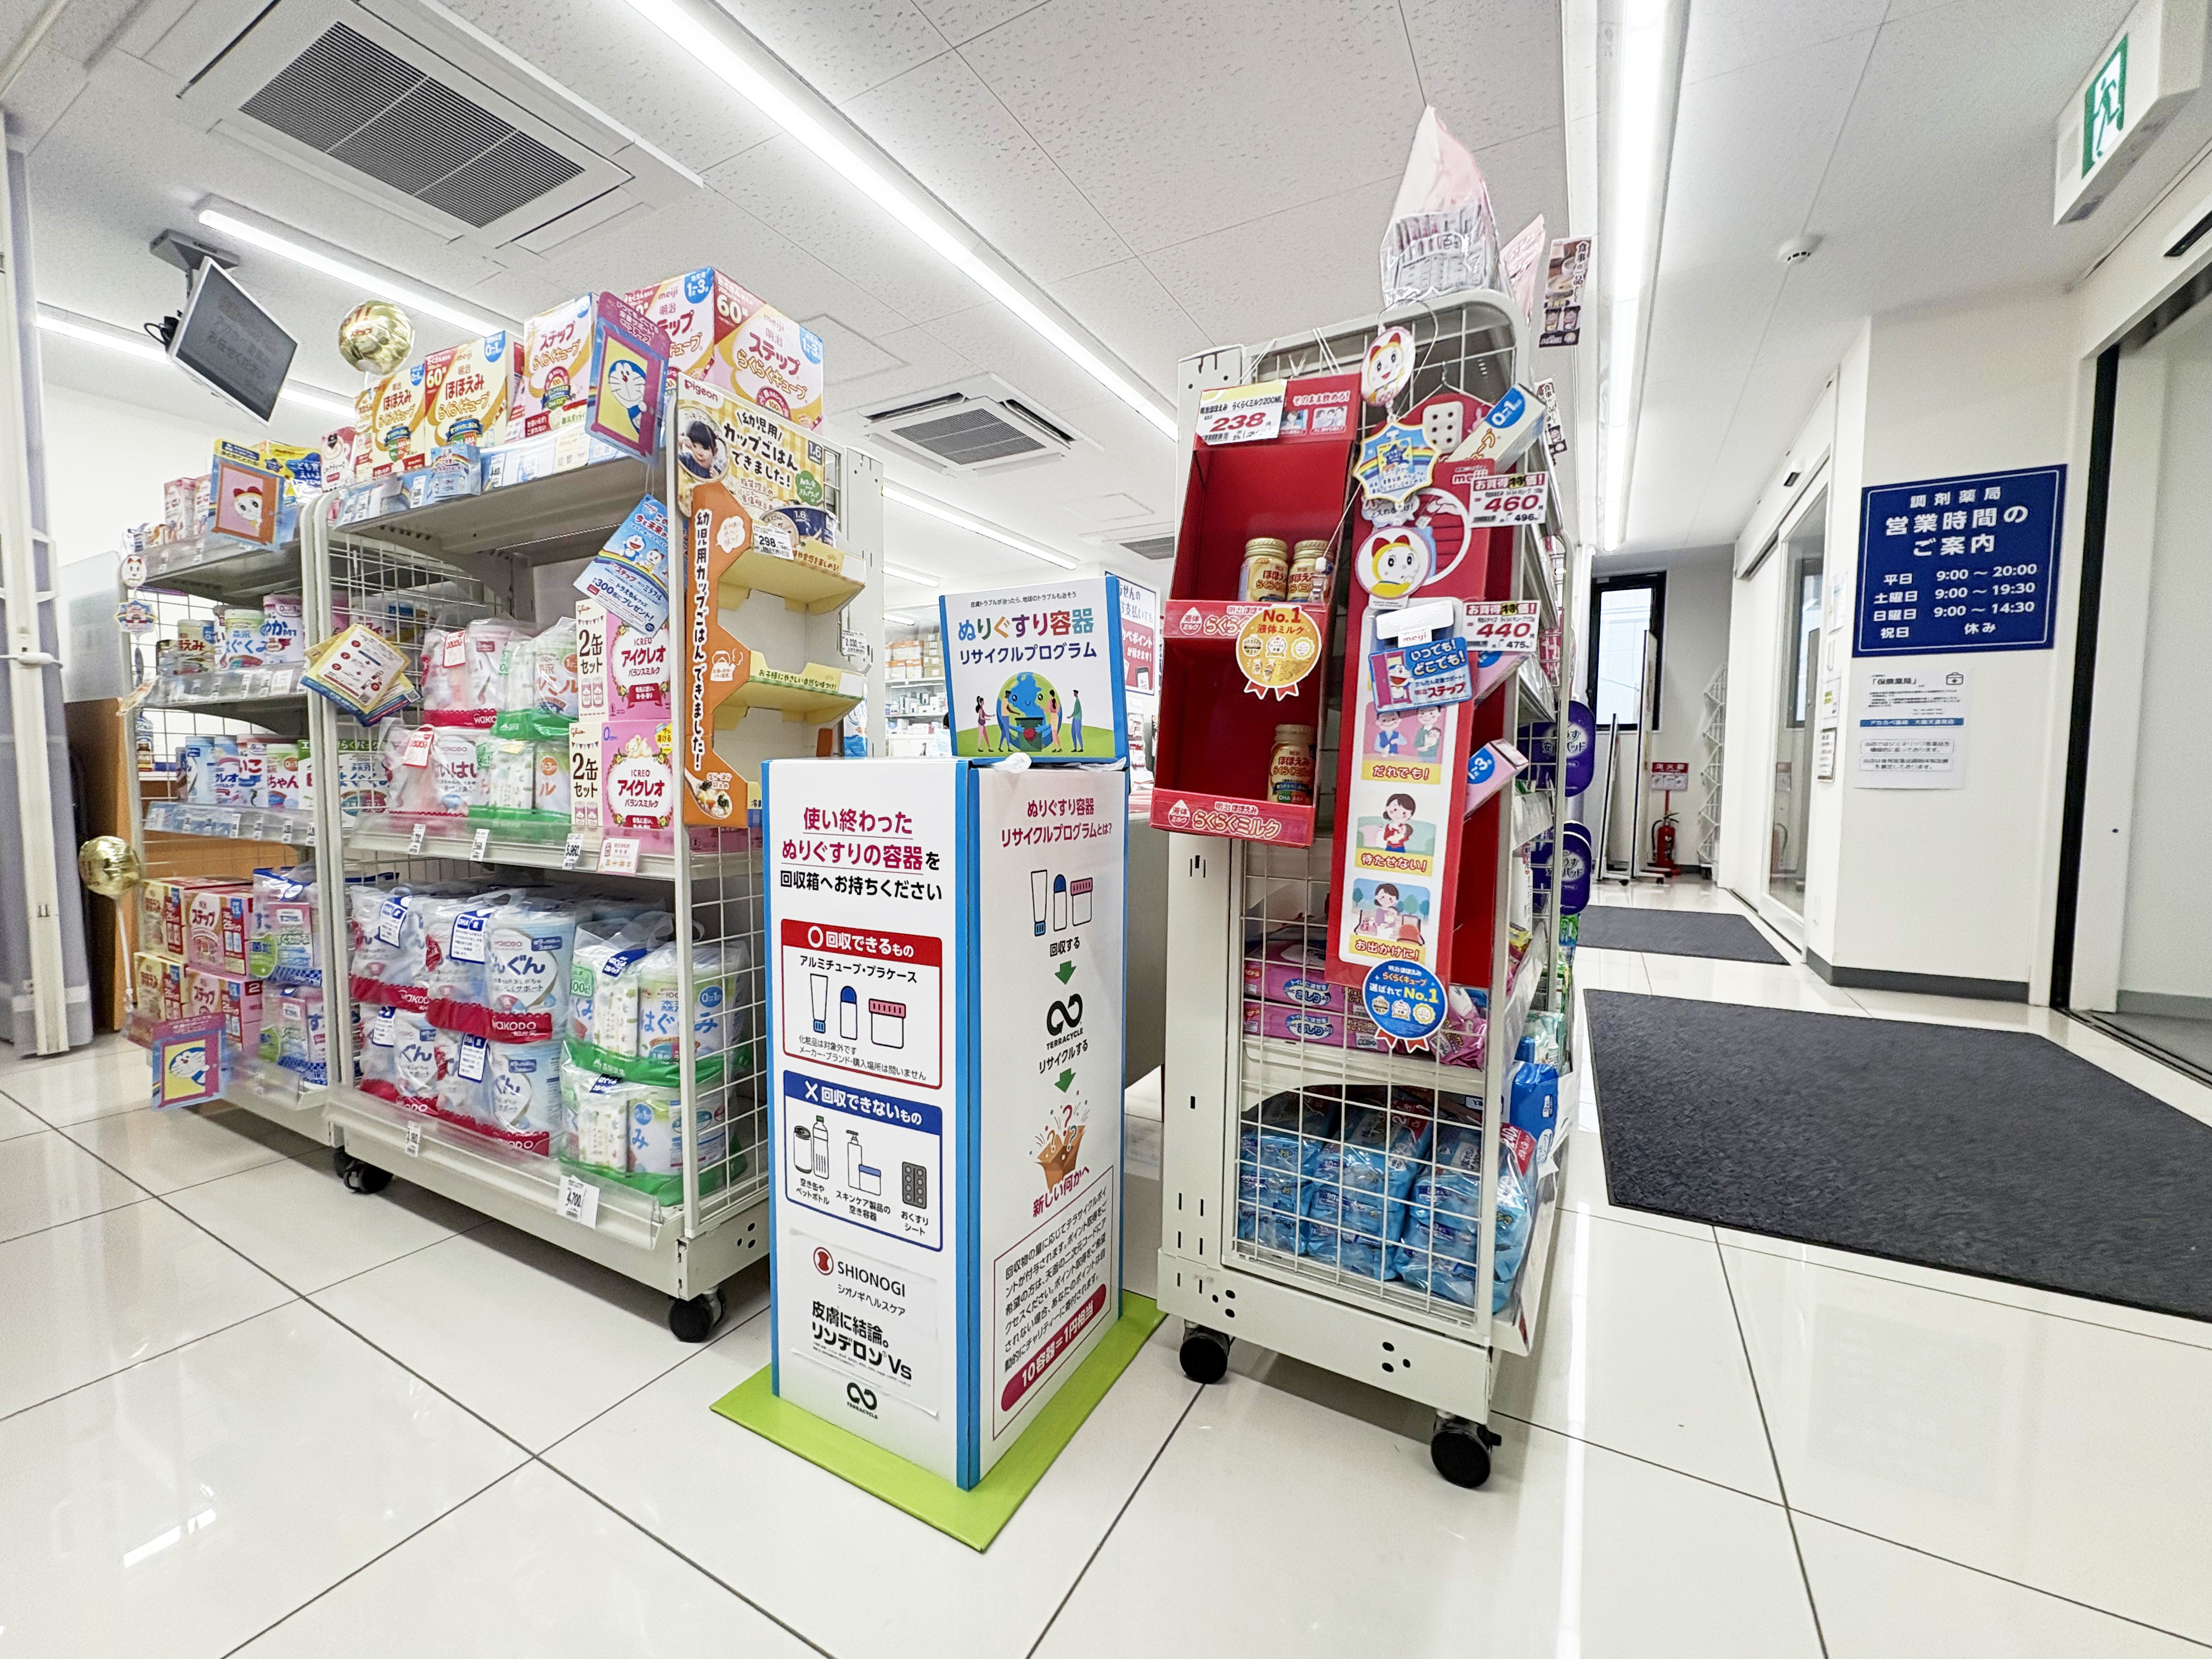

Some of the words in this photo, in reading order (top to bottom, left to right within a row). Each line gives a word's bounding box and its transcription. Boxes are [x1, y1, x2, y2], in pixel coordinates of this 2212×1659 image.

[540, 321, 575, 351] ステップ
[749, 331, 800, 375] ステップ
[737, 349, 808, 400] らくらくキューブ
[445, 374, 485, 400] ほほえみ
[383, 390, 411, 412] ほほえみ
[742, 413, 778, 438] 幼児用
[1209, 412, 1267, 432] 238
[723, 423, 799, 472] カップごはん
[732, 450, 791, 488] できました!
[1484, 495, 1539, 512] 460
[1909, 486, 2001, 509] 調剤薬局
[1885, 505, 2029, 536] 営業時間の
[759, 535, 777, 548] 298
[1913, 534, 1995, 557] ご案内
[1883, 573, 1913, 586] 平日
[1936, 568, 1969, 582] 9:00
[1993, 563, 2038, 578] 20:00
[1874, 590, 1918, 605] 土曜日
[1934, 587, 1968, 600] 9:00
[1993, 582, 2036, 596] 19:30
[1262, 606, 1301, 624] No.1
[1873, 608, 1917, 622] 日曜日
[1933, 605, 1967, 618] 9:00
[1991, 601, 2035, 614] 14:30
[958, 607, 1094, 641] ぬりぐすり容器
[1257, 624, 1305, 635] 液体ミルク
[1476, 623, 1531, 638] 440
[1880, 627, 1910, 640] 祝日
[1964, 623, 1996, 635] 休み
[579, 629, 603, 657] 2缶
[1403, 631, 1427, 642] meiji
[621, 645, 667, 668] アイクレオ
[960, 641, 1097, 665] リサイクルプログラム
[1410, 639, 1457, 661] いつでも!
[580, 658, 603, 675] セット
[628, 667, 661, 678] バランスミルク
[1413, 650, 1466, 676] どこでも!
[572, 752, 599, 780] 2缶
[1278, 756, 1310, 766] ほほえみ
[631, 769, 651, 778] ICREO
[1373, 765, 1430, 781] だれでも!
[574, 778, 599, 799] セット
[617, 779, 665, 797] アイクレオ
[624, 798, 659, 809] バランスミルク
[1027, 797, 1094, 818] ぬりぐすり容器
[803, 806, 913, 834] 使い終わった
[1193, 811, 1280, 838] らくらくミルク
[1001, 822, 1113, 848] リサイクルプログラムとは?
[782, 839, 940, 871] ぬりぐすりの容器を
[1361, 854, 1427, 872] 待たせない!
[780, 870, 943, 901] 回収箱へお持ちください
[1049, 936, 1080, 958] 回収する
[1355, 940, 1419, 961] お出かけに!
[799, 955, 917, 984] アルミチューブ・プラケース
[1382, 972, 1427, 987] らくらくキューブ
[1403, 986, 1438, 1004] No.1
[799, 1035, 857, 1054] 化粧品は対象外です
[1046, 1026, 1084, 1051] TERRACYCLE
[799, 1047, 927, 1081] メーカー・ブランド・購入場所は問いません
[1039, 1038, 1089, 1075] リサイクルする
[796, 1187, 830, 1205] ペットボトル
[800, 1178, 825, 1192] 空き缶や
[1032, 1165, 1090, 1218] 新しい何かへ
[836, 1190, 891, 1215] スキンケア製品の
[849, 1205, 877, 1222] 空き容器
[901, 1210, 929, 1226] おくすり
[905, 1223, 926, 1236] シート
[1005, 1186, 1107, 1281] 回収物の量に応じてテラサイクルポイ
[1005, 1201, 1107, 1299] ントが付与されます。ポイント取得をご
[838, 1261, 905, 1297] SHIONOGI
[837, 1284, 906, 1316] シオノギヘルスケア
[1005, 1248, 1106, 1353] されない場合、あなたのポイントは自
[812, 1300, 889, 1348] 皮膚に結論。
